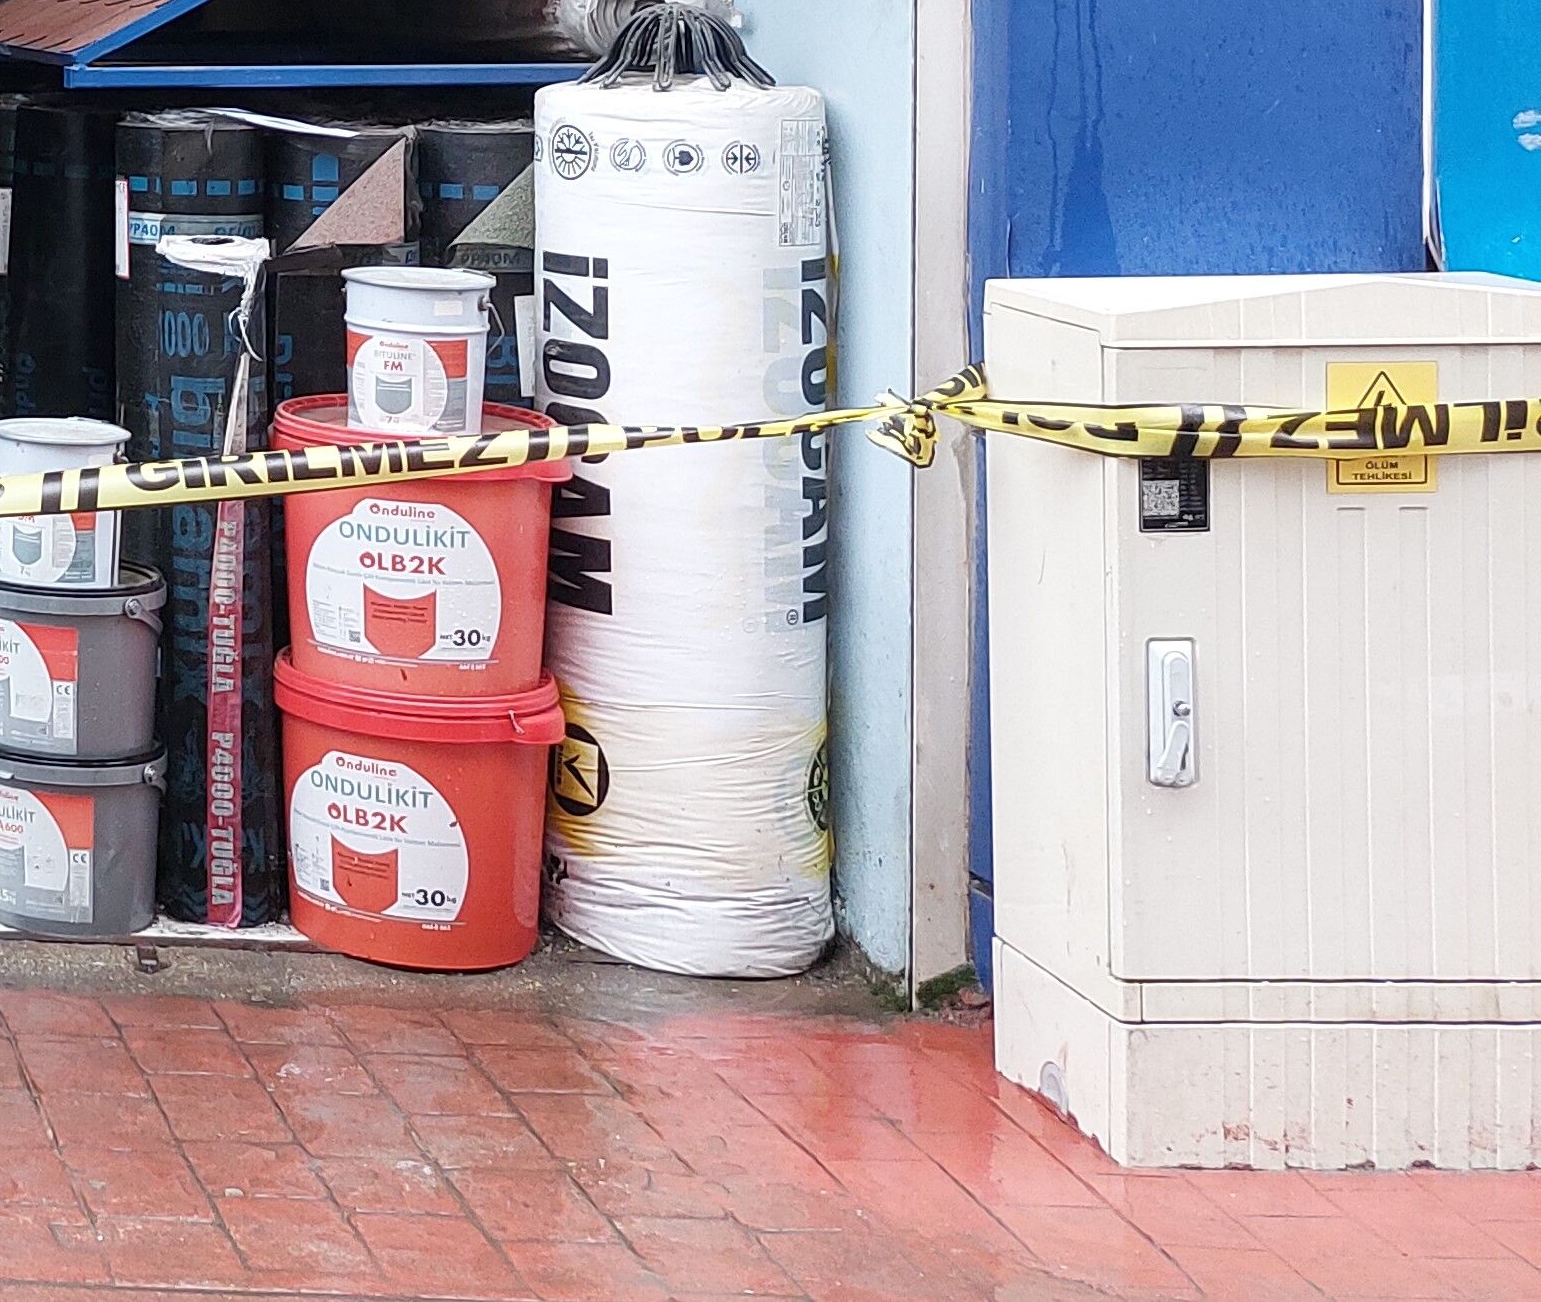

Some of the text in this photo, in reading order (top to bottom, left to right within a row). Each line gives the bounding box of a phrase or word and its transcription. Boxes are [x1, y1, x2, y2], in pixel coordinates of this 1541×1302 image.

[383, 360, 403, 372] FM
[1365, 459, 1399, 470] ÖLÜM
[1352, 471, 1413, 481] TEHLİKESİ
[370, 503, 436, 519] Onduline
[339, 520, 470, 549] ONDULİKİT
[452, 628, 482, 647] 30
[335, 756, 398, 777] Onduline
[311, 770, 433, 809] ONDULİKİT
[414, 889, 446, 907] 30
